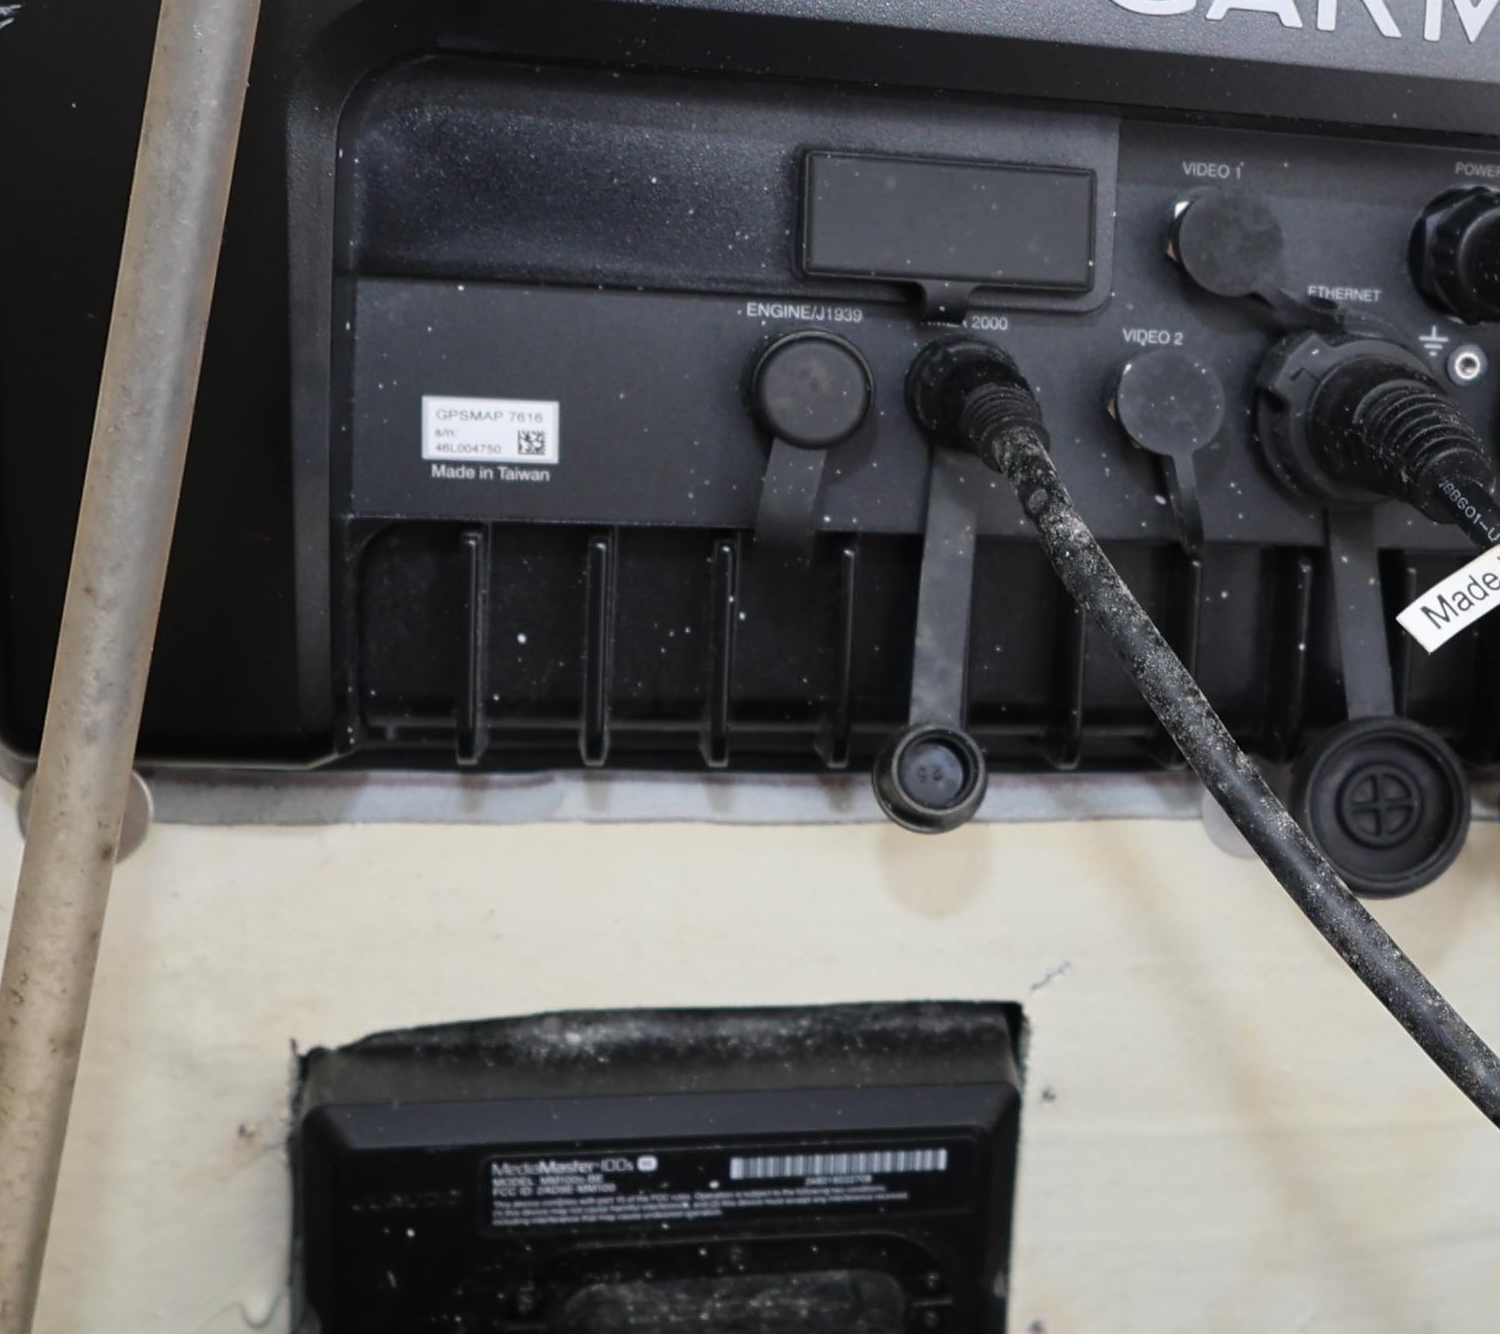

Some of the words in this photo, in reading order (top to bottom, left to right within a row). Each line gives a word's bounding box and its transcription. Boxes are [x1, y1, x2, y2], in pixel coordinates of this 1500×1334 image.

[1182, 160, 1230, 179] VIDEO
[1235, 165, 1242, 180] 1
[1307, 285, 1383, 303] ETHERNET
[746, 302, 863, 323] ENGINE/J1939
[971, 315, 1009, 331] 2000
[1122, 328, 1171, 345] VIDEO
[1173, 331, 1184, 346] 2
[435, 409, 503, 423] GPSMAP
[431, 464, 476, 479] Made
[479, 465, 494, 480] in
[499, 467, 550, 482] Taiwan
